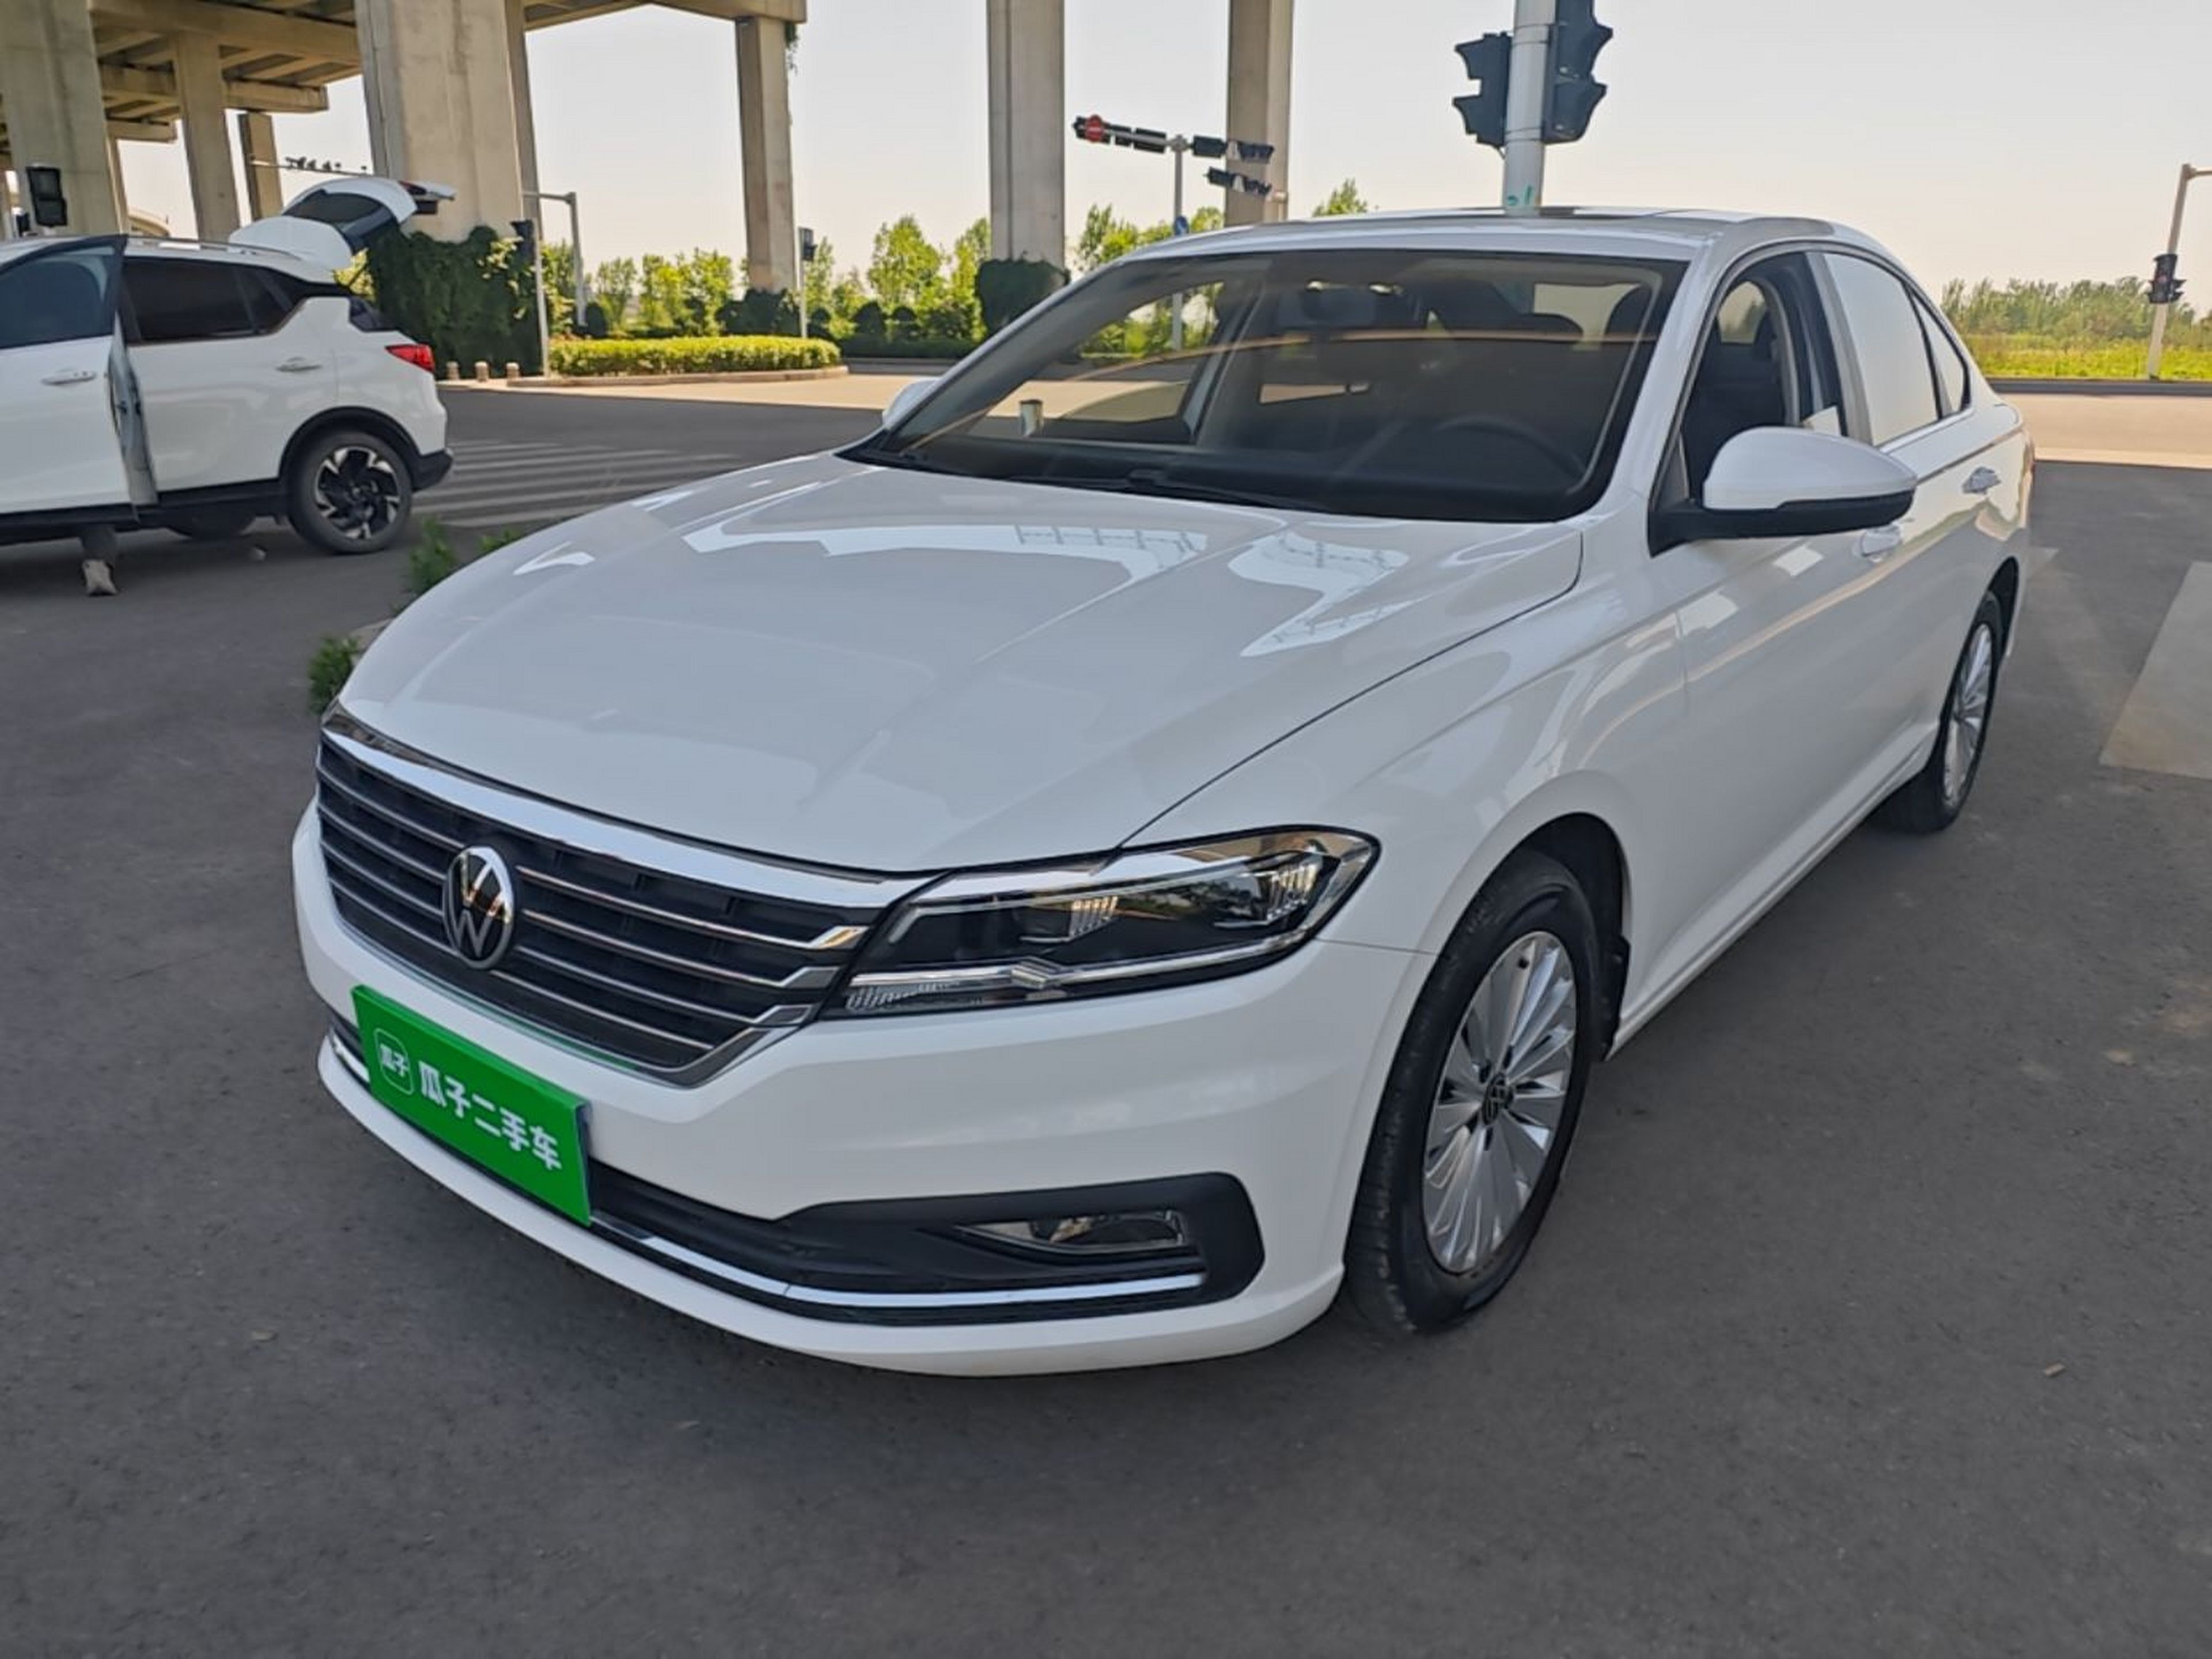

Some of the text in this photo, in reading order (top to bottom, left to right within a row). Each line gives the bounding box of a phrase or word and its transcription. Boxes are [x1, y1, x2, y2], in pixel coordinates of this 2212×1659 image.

[418, 1060, 563, 1171] 瓜子二手车
